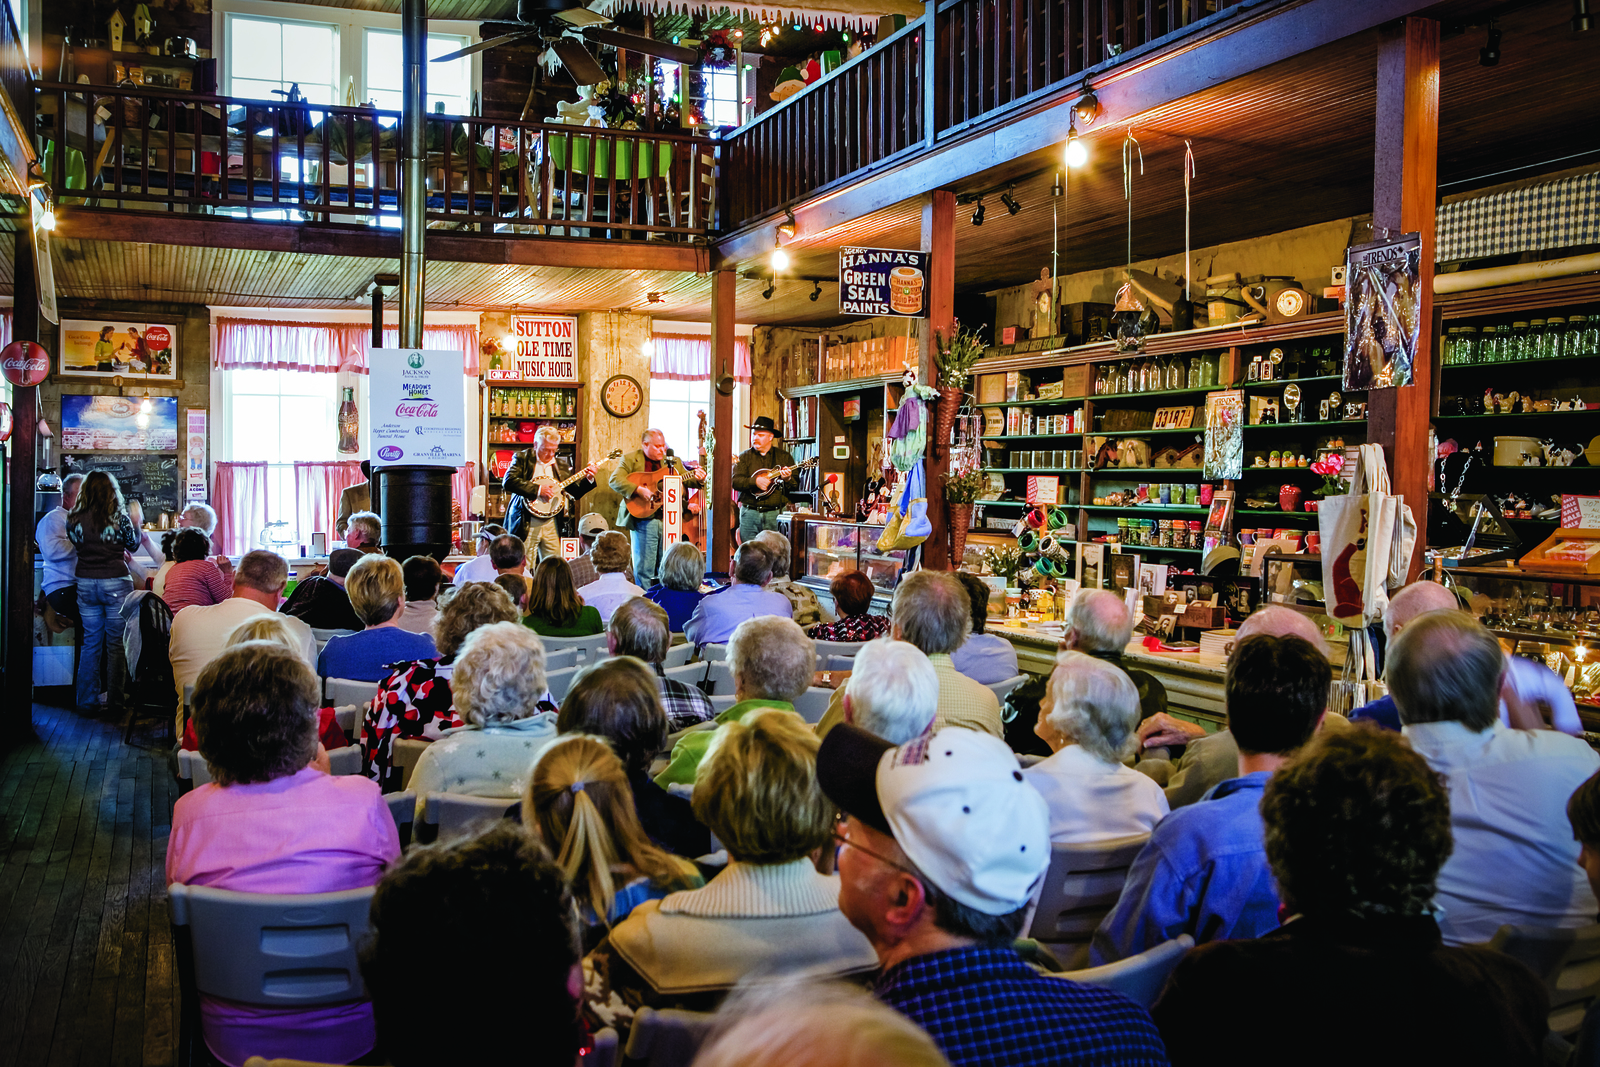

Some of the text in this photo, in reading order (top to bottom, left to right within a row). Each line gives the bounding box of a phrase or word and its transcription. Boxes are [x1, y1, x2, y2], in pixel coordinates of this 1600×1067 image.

[841, 252, 919, 269] HANNA'S
[1367, 246, 1398, 265] TRENDS
[843, 268, 886, 286] GREEN
[847, 284, 883, 302] SEAL
[843, 301, 890, 314] PAINTS
[516, 320, 572, 338] SUTTON
[516, 340, 573, 357] OLE TIME
[3, 356, 47, 371] Coca-Cola
[516, 360, 573, 378] MUSIC HOUR
[491, 371, 519, 379] ON AIR
[402, 383, 432, 391] MEADOWS
[408, 389, 429, 397] HOMES
[395, 403, 439, 418] Coca-Cola
[380, 448, 400, 458] Purity
[1563, 500, 1577, 510] SALE
[1563, 506, 1579, 516] SALE
[1562, 512, 1582, 524] SALE
[1563, 520, 1580, 528] SALE
